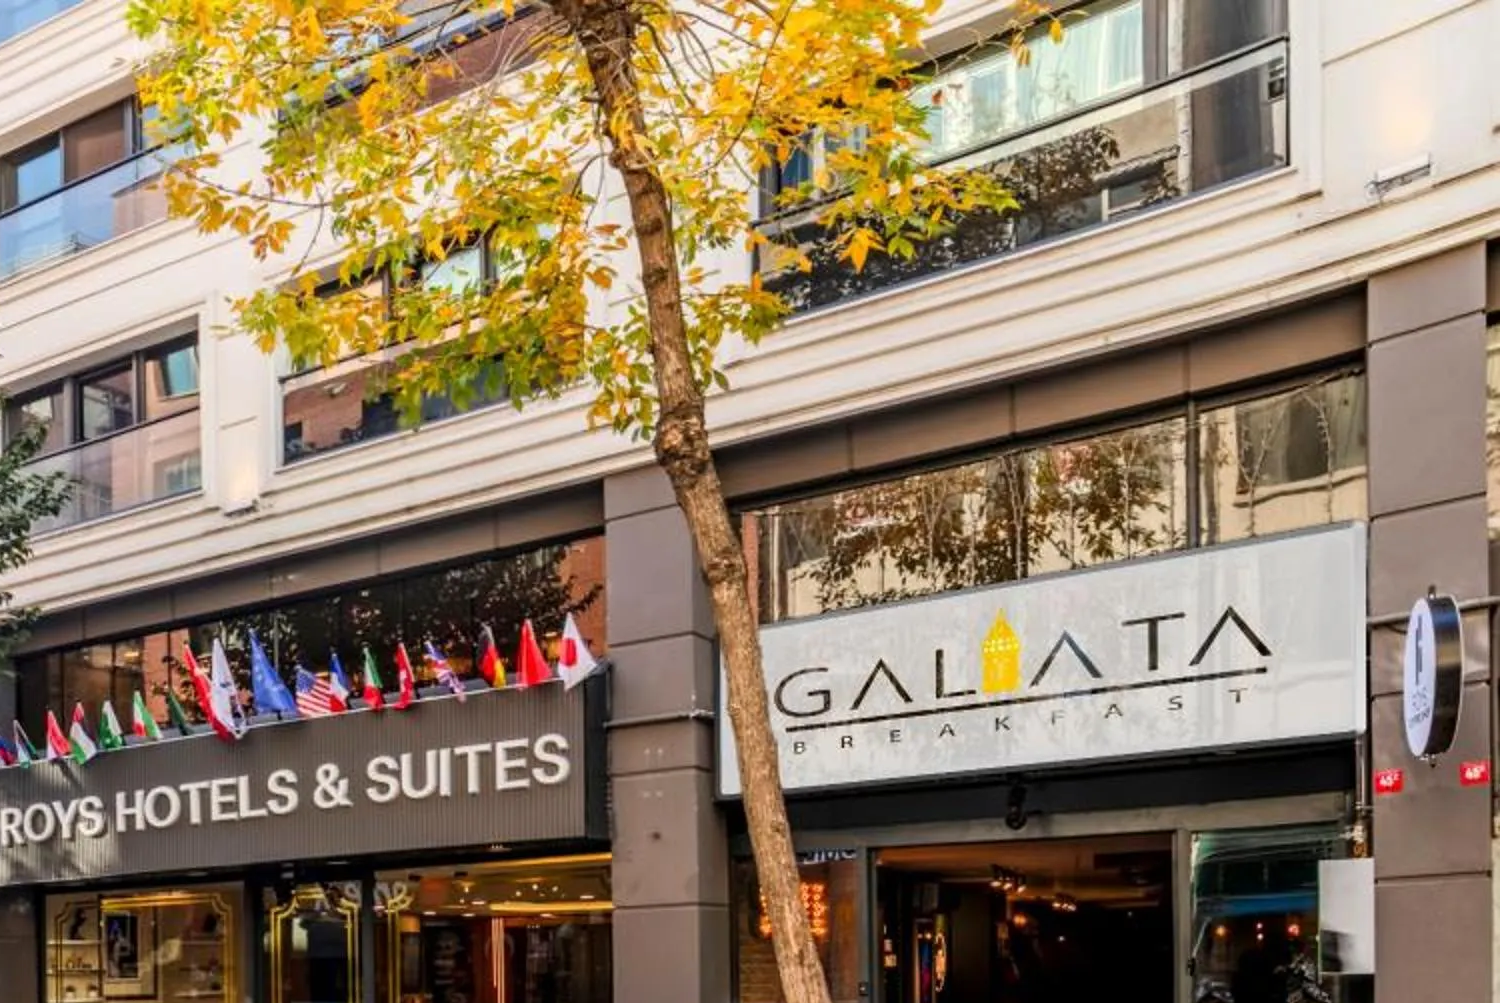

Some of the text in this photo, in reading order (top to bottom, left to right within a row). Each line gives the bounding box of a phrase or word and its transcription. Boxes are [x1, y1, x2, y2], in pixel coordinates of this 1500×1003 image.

[774, 606, 1273, 719] GALATA
[793, 687, 1248, 755] BREAKFAST
[0, 733, 571, 847] ROYS HOTELS & SUITES
